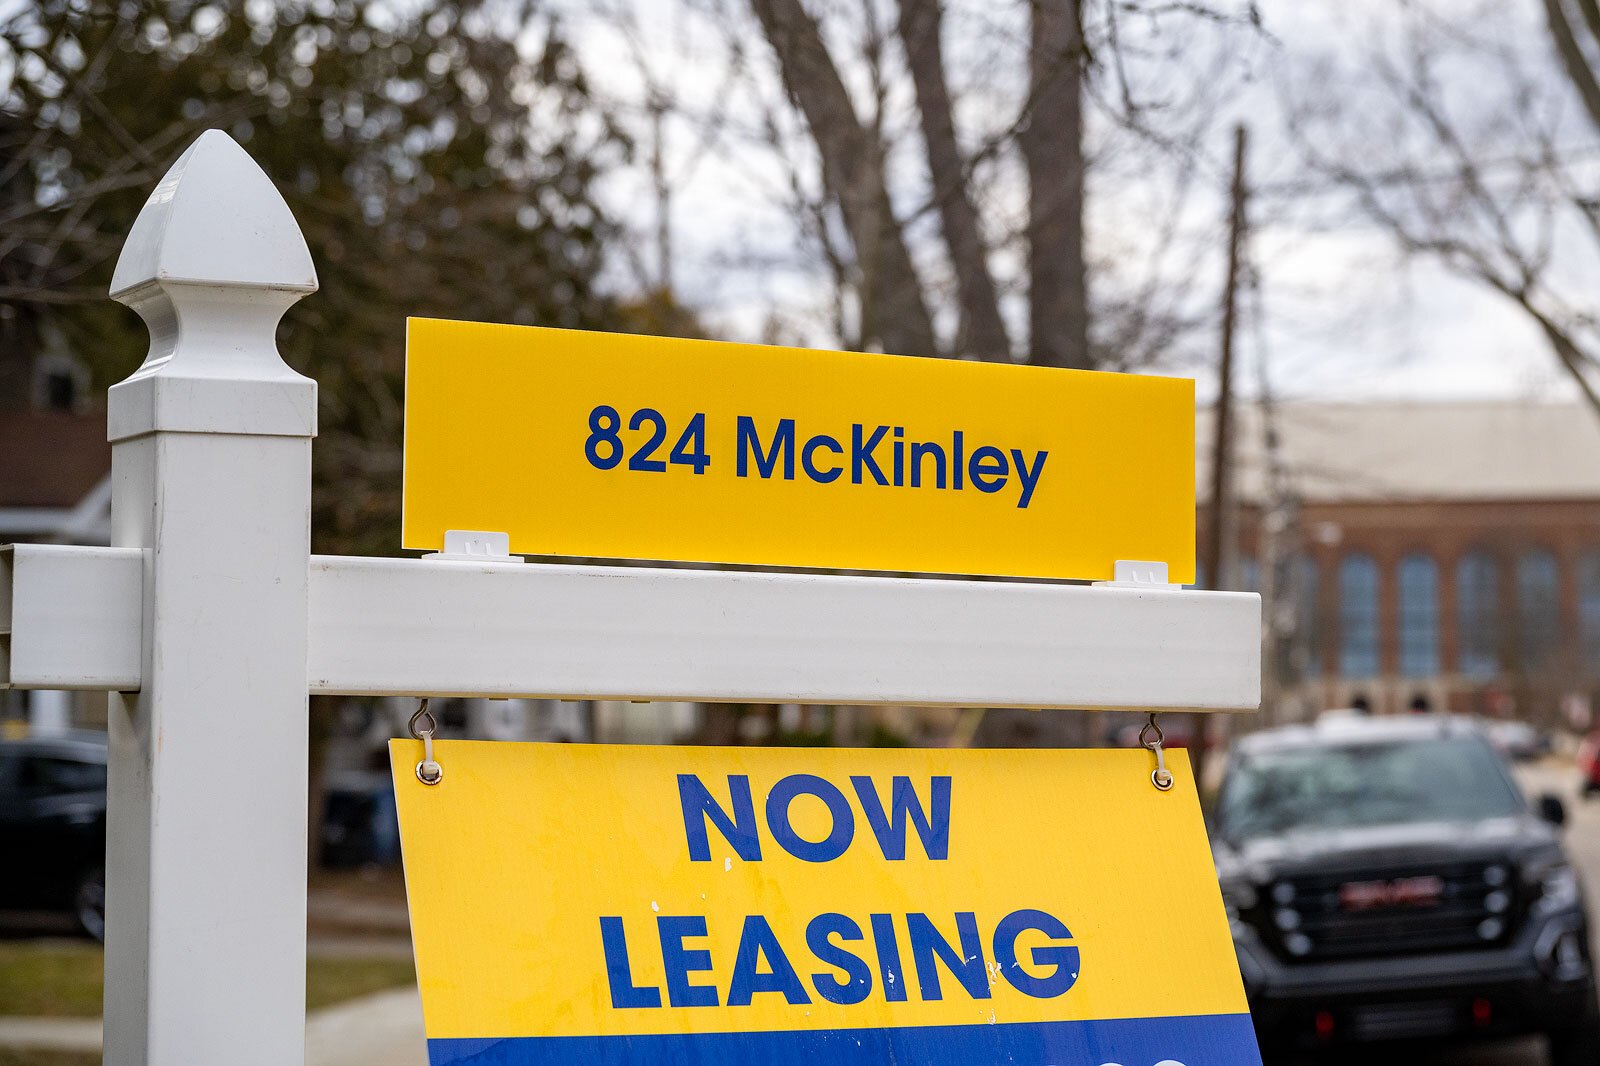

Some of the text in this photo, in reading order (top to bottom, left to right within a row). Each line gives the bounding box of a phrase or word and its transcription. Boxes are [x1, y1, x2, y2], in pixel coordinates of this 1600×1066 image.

[585, 405, 1048, 509] 824 McKinley
[677, 773, 952, 863] NOW
[600, 909, 1080, 1009] LEASING
